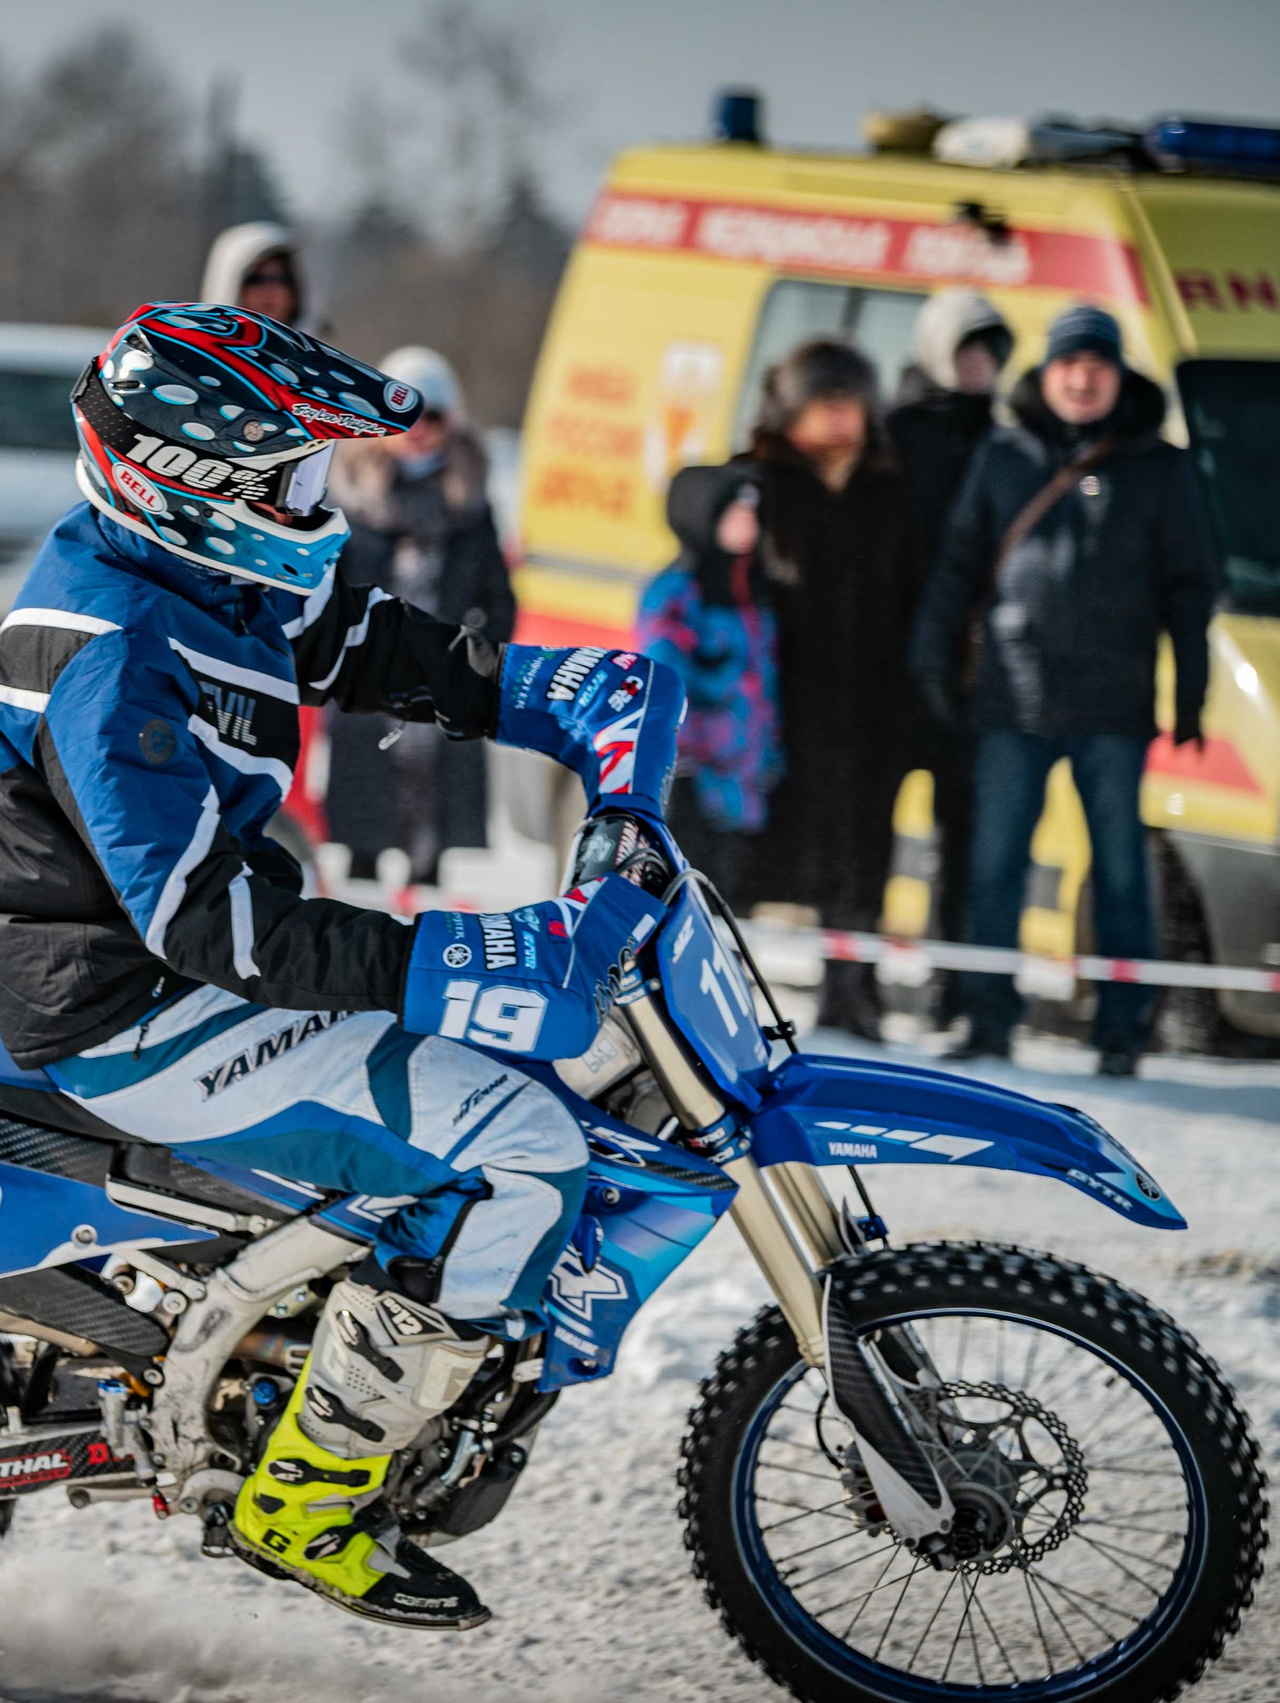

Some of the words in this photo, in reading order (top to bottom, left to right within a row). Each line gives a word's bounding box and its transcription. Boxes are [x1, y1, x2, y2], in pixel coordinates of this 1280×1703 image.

[291, 403, 315, 423] Troy
[314, 407, 338, 424] Lee
[390, 385, 410, 407] BELL
[125, 433, 279, 501] 100%
[120, 469, 155, 509] BELL
[442, 980, 549, 1053] 19
[828, 1141, 878, 1159] YAMAHA
[1065, 1168, 1134, 1212] GYTR
